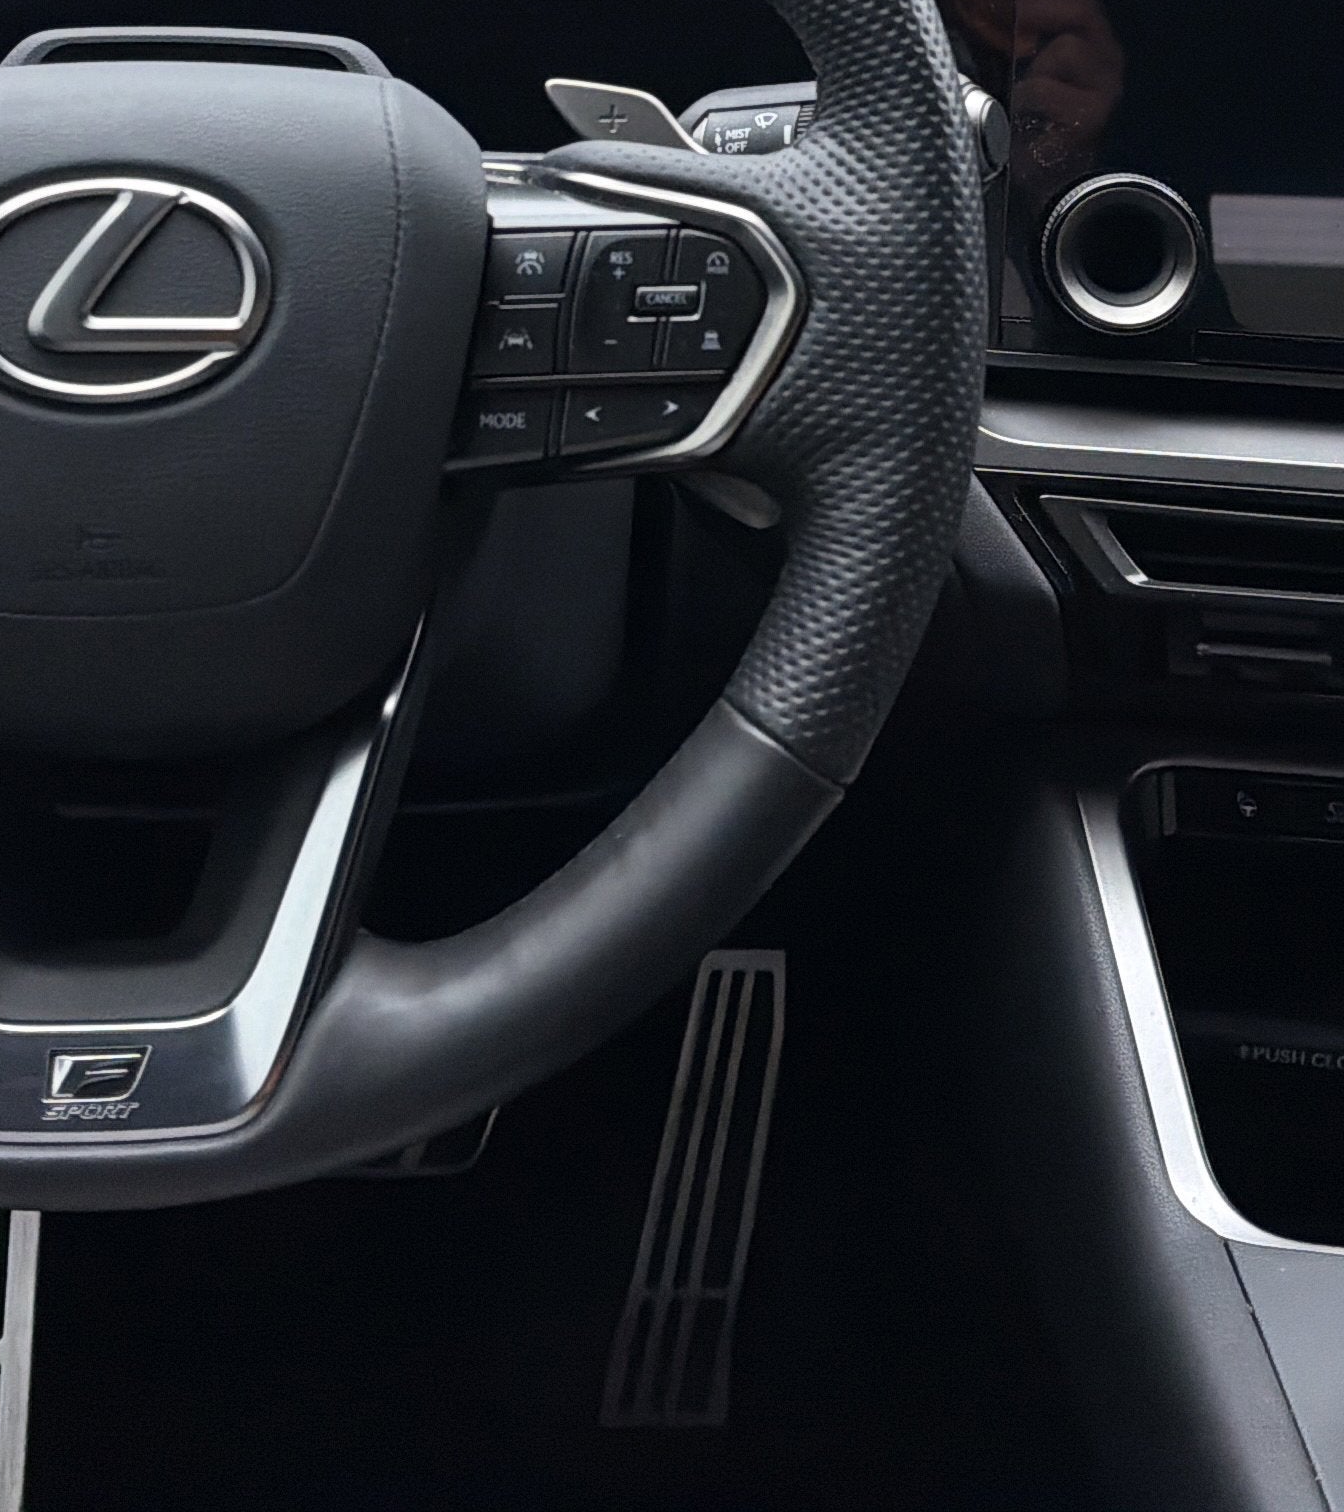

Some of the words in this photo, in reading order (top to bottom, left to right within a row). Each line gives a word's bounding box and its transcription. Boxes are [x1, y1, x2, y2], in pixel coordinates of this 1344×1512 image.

[725, 127, 752, 140] MIST
[725, 141, 747, 153] OFF
[610, 251, 633, 265] RES
[645, 293, 687, 306] CANCEL
[479, 412, 527, 429] MODE
[1253, 1046, 1305, 1065] PUSH
[41, 1102, 140, 1120] SPORT
